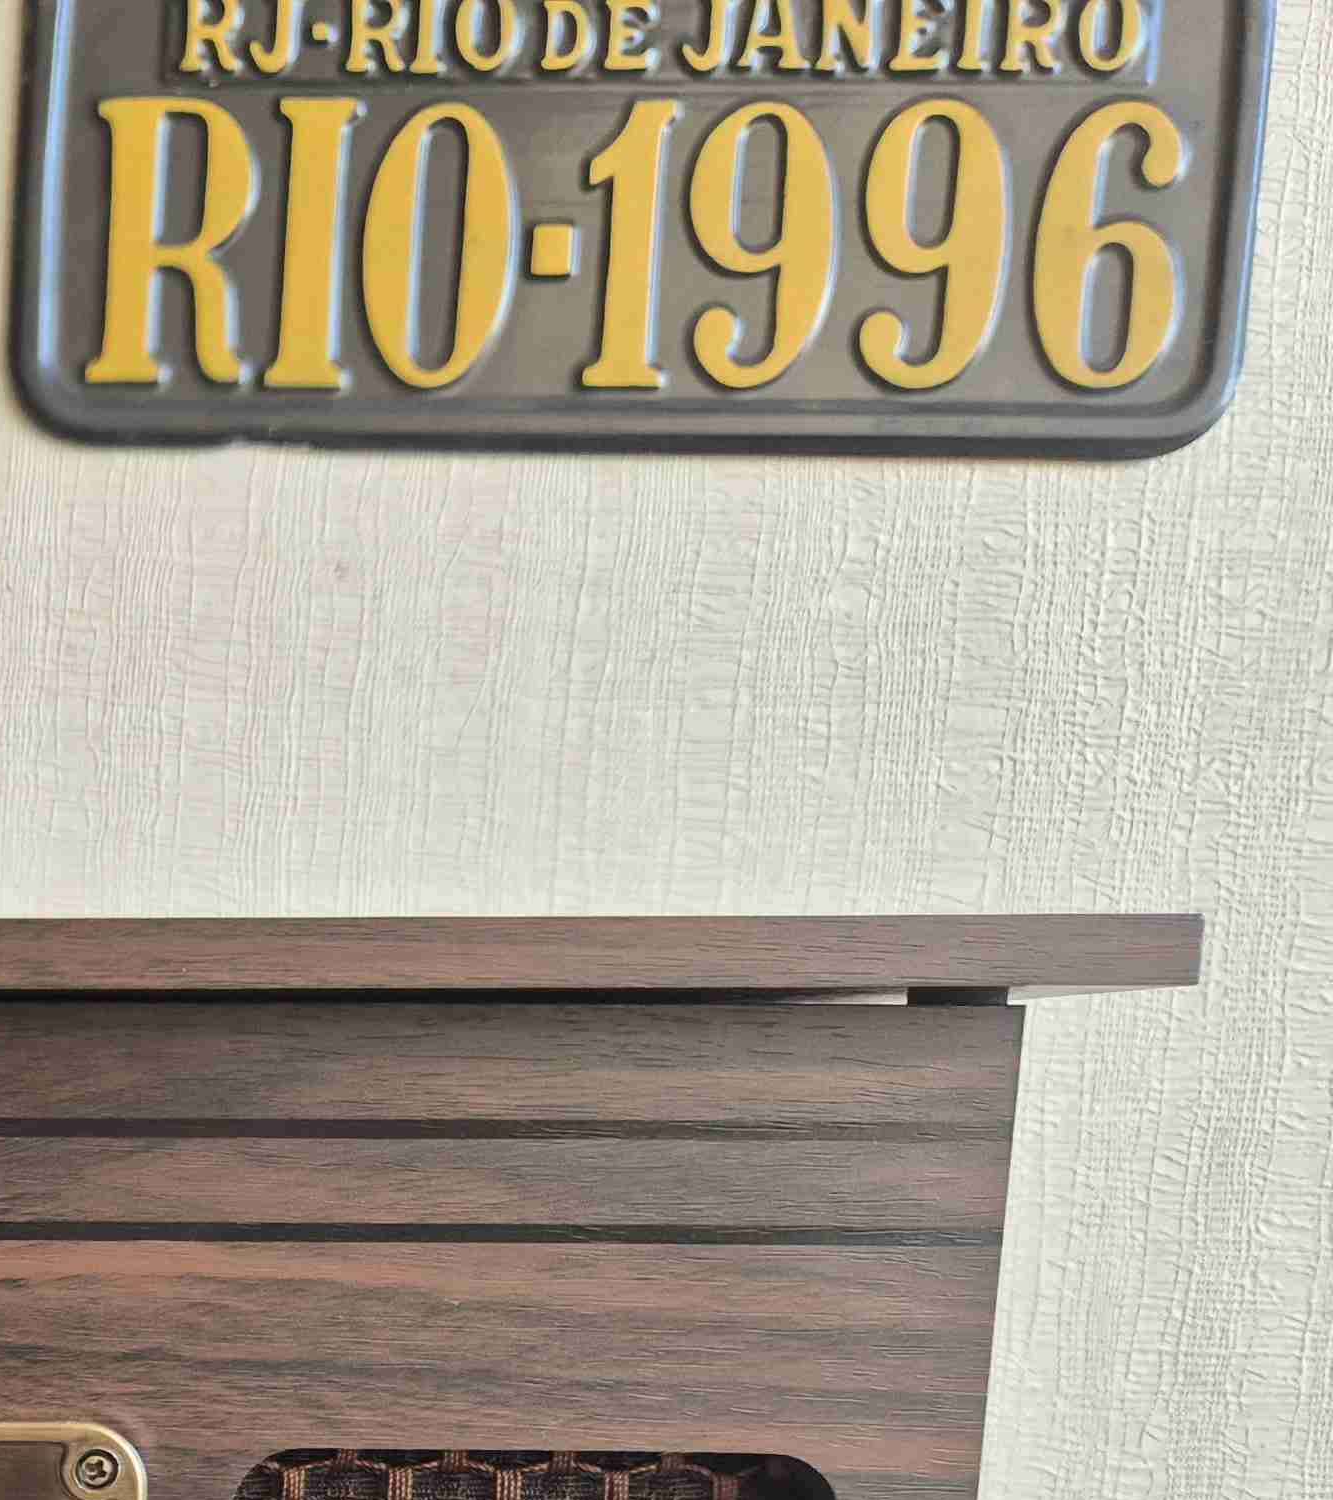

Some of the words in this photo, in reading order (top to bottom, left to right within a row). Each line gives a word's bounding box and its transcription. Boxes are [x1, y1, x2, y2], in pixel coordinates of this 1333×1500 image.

[539, 0, 659, 74] DE
[681, 0, 1141, 74] JANEIRO
[84, 96, 1191, 392] RIO-1996
